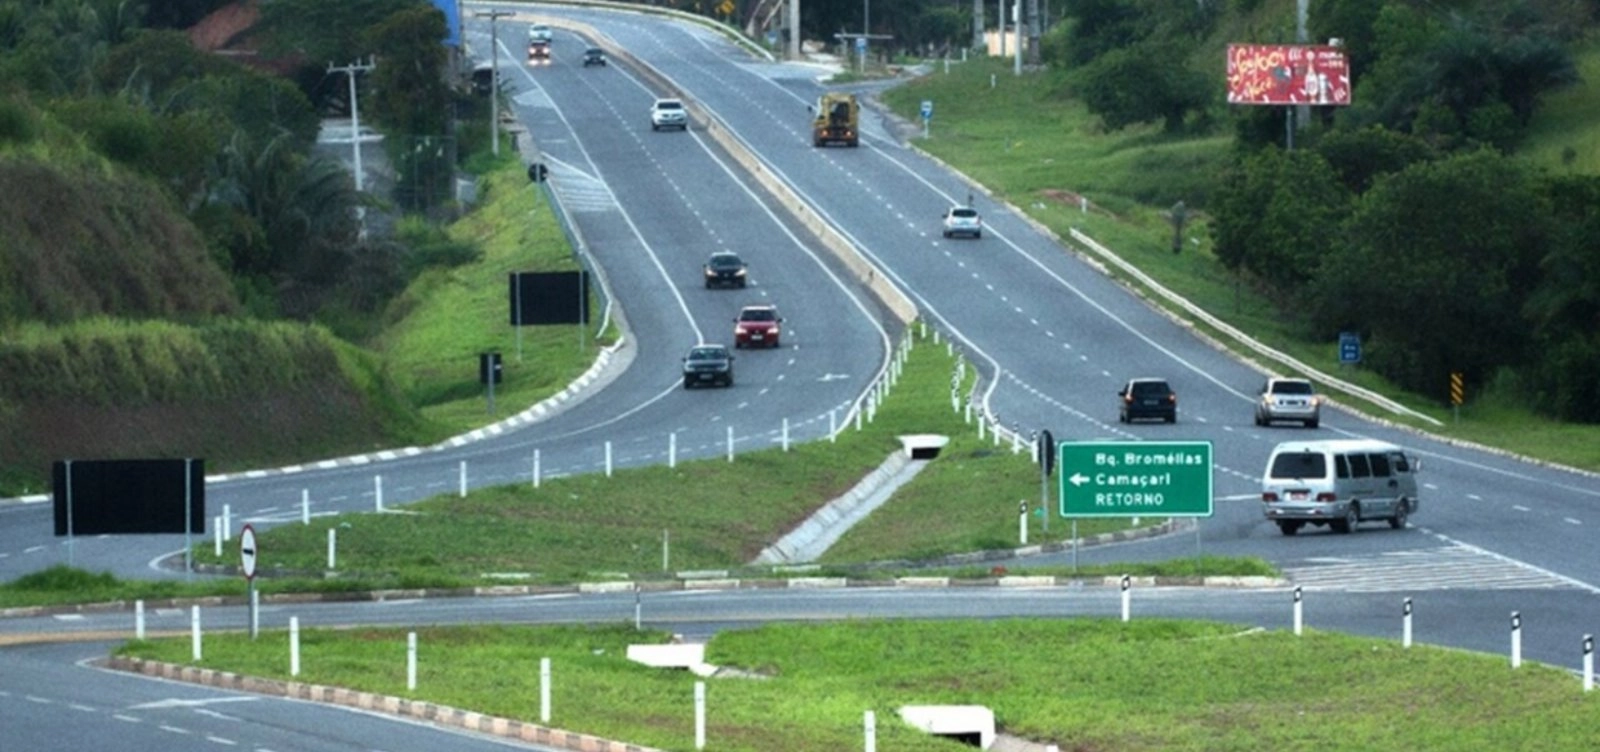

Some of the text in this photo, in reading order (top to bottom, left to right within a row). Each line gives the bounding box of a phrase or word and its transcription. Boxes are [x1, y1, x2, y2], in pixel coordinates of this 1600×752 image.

[1095, 452, 1203, 467] Bq. Bromélias
[1095, 472, 1171, 487] Camaçari
[1095, 493, 1164, 505] RETORNO
